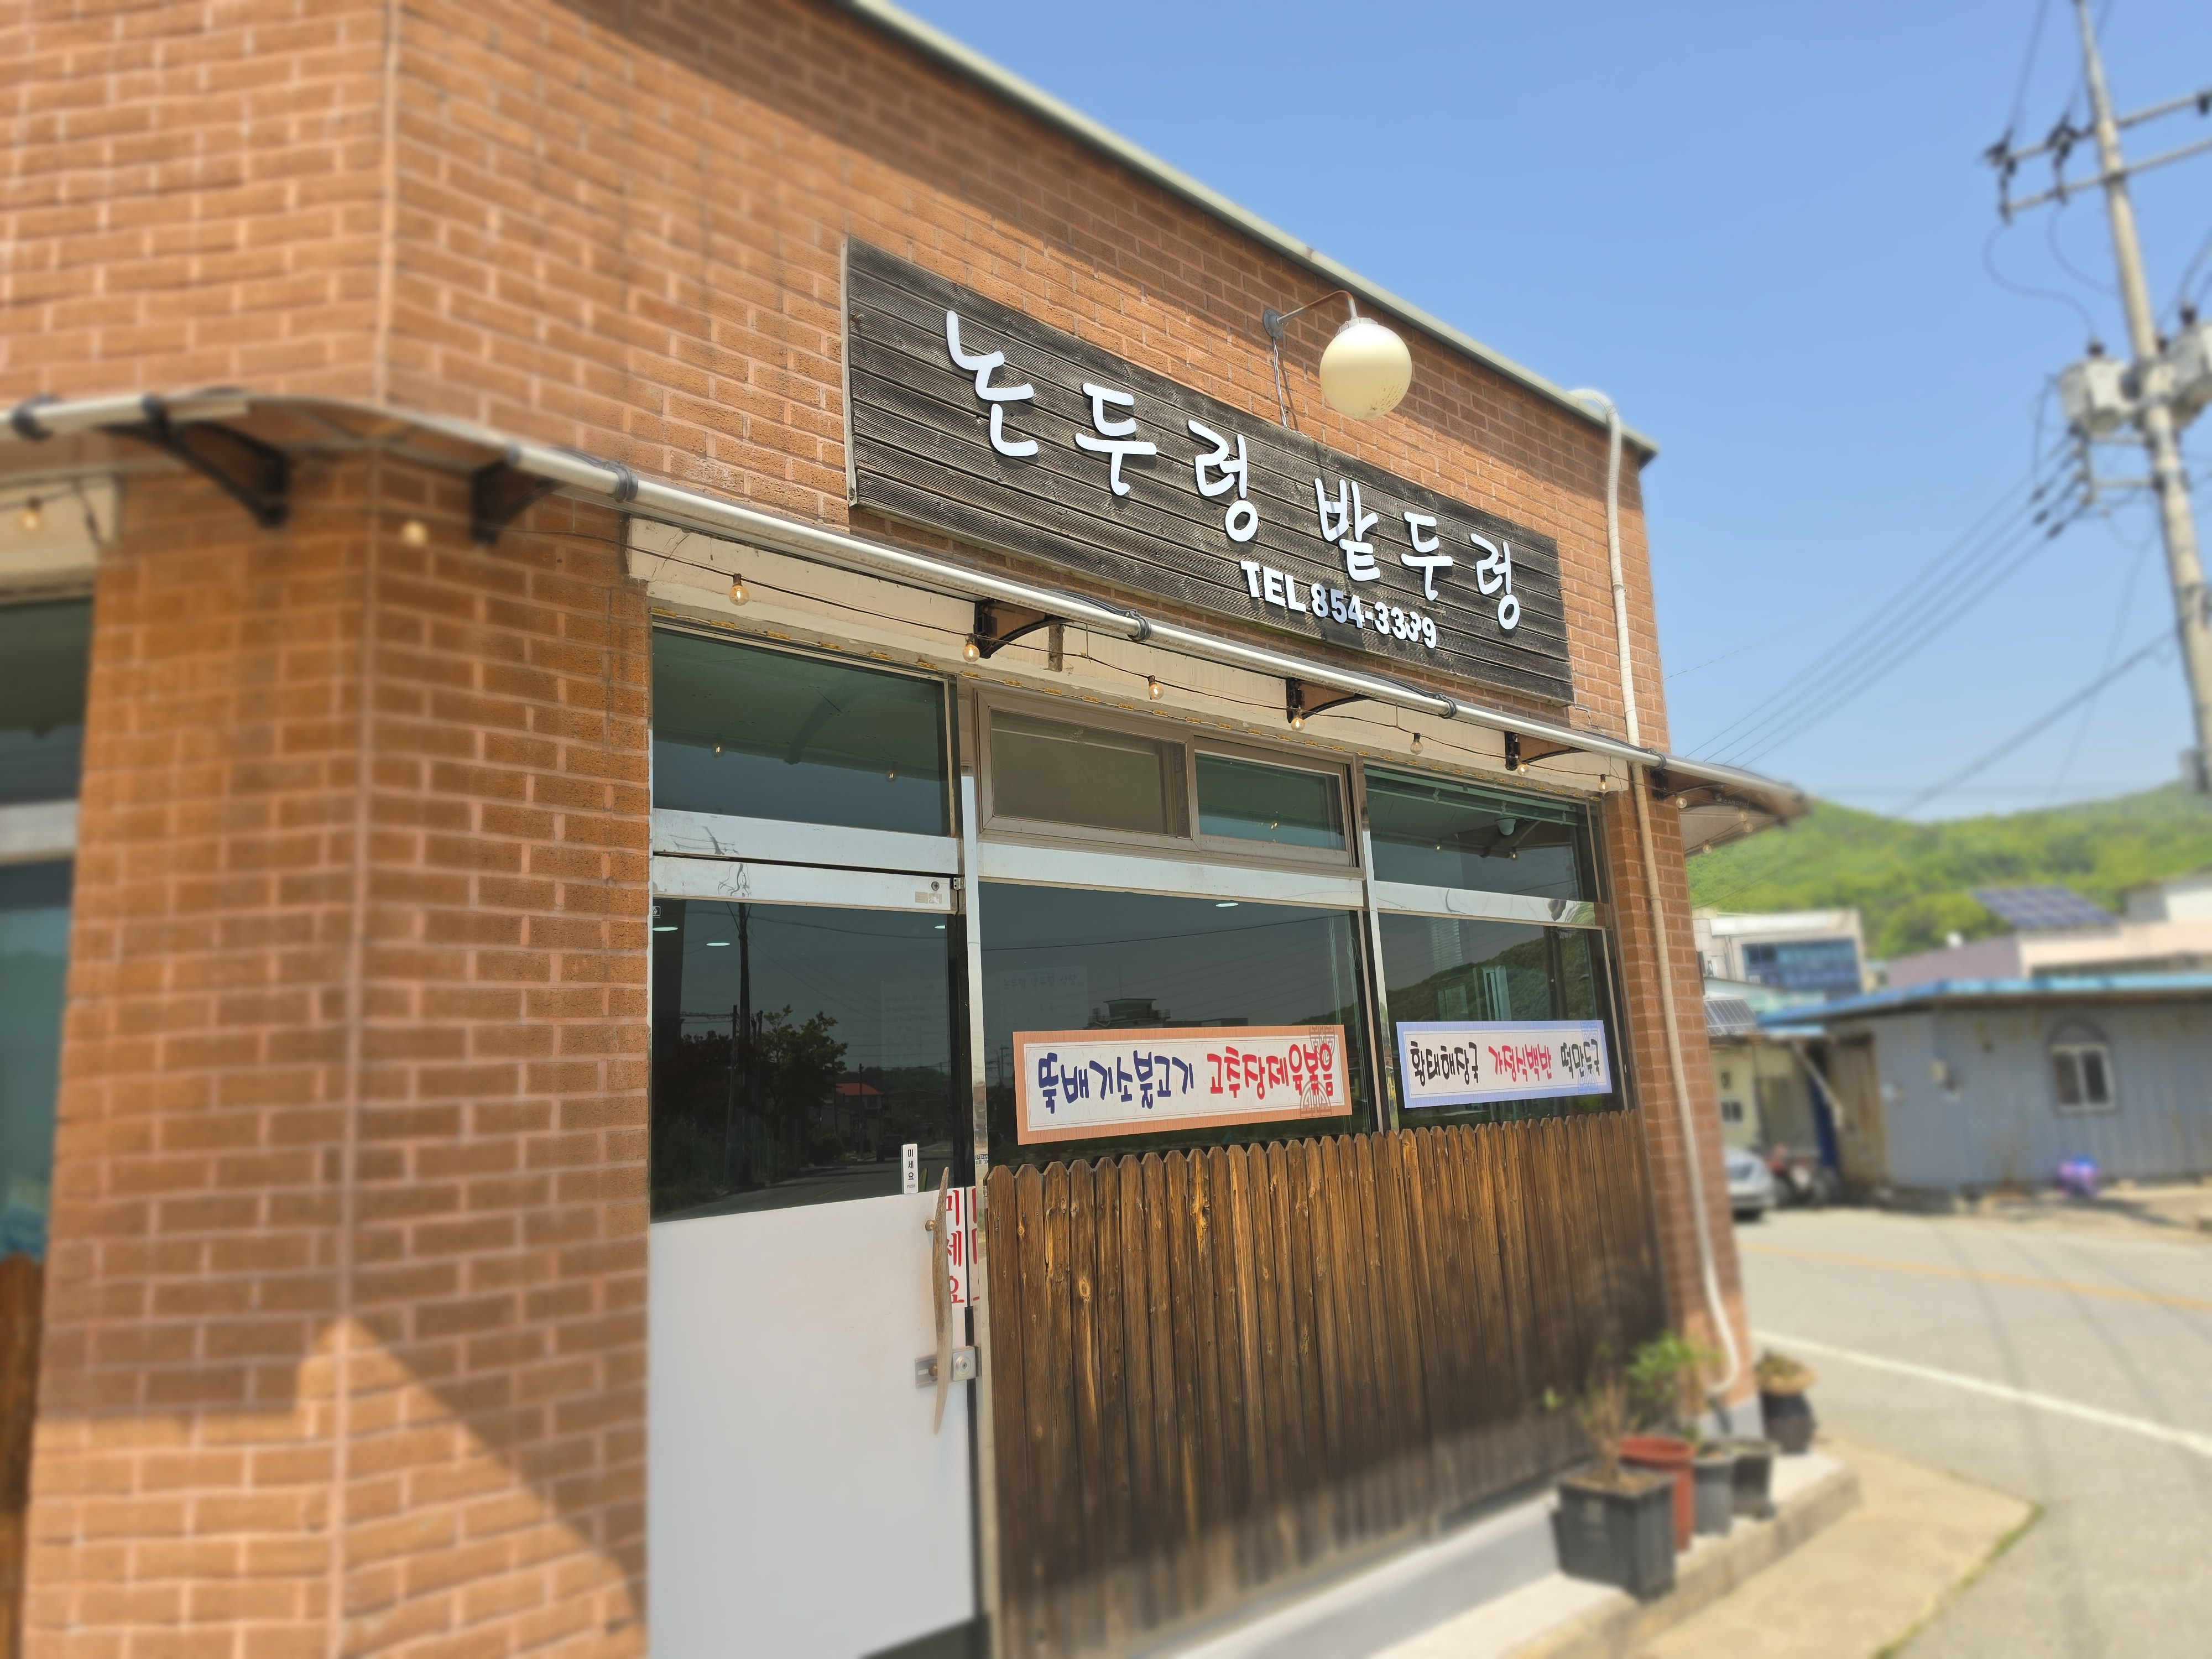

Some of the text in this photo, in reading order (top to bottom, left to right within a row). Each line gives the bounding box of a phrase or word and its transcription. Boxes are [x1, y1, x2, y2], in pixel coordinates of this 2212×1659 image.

[946, 310, 1520, 631] 논두렁 밭두렁
[1239, 560, 1437, 649] TEL 854-3339
[1038, 1043, 1333, 1114] 뚝배기소불고기 고추장제육볶음
[1410, 1039, 1600, 1086] 황태해장국 가정식백반 떡만두국
